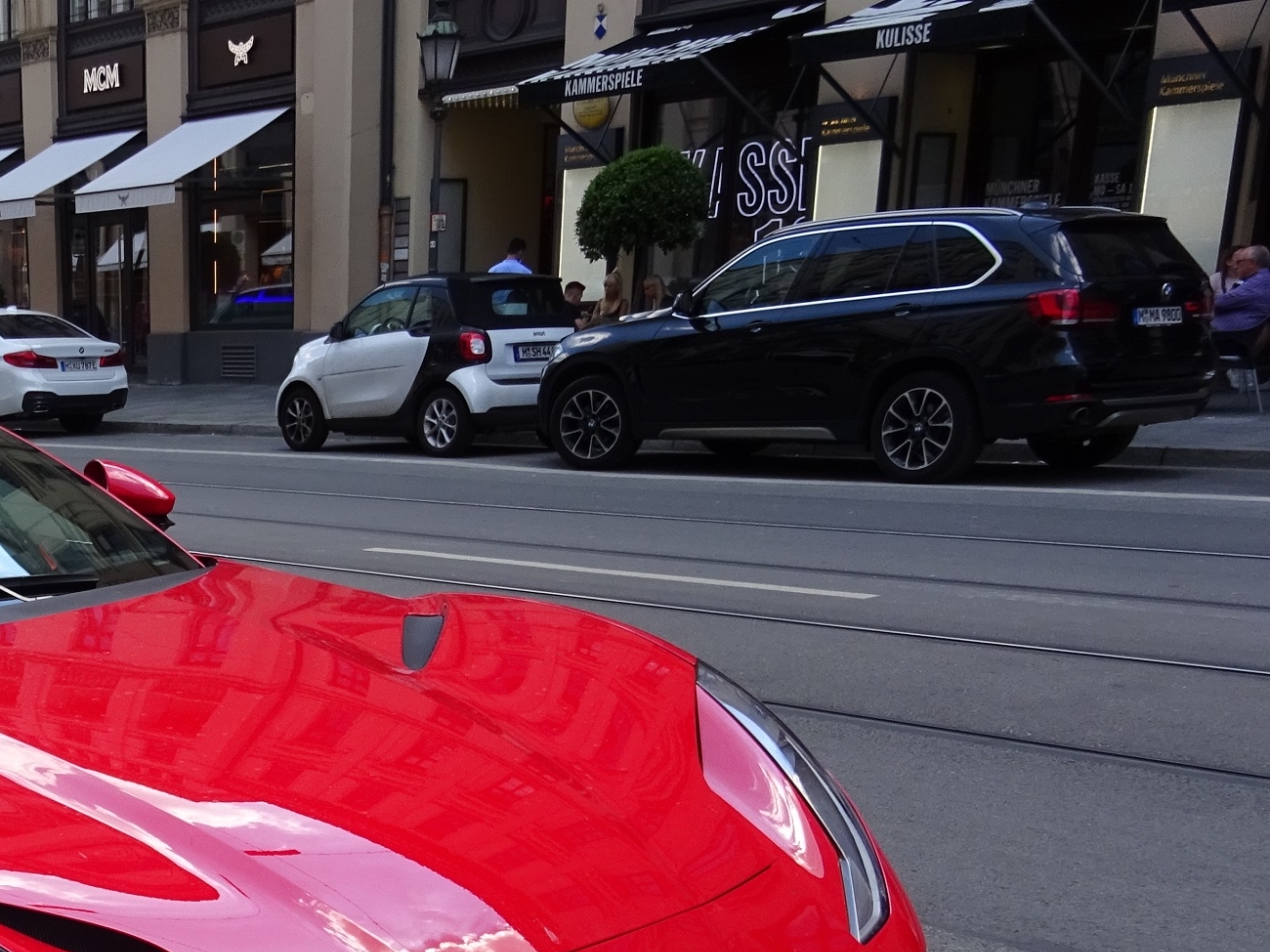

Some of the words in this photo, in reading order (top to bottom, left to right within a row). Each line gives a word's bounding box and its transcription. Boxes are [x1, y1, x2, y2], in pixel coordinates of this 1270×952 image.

[875, 22, 932, 49] KULISSE
[83, 63, 120, 93] MCM
[564, 68, 644, 97] KAMMERSPIELE
